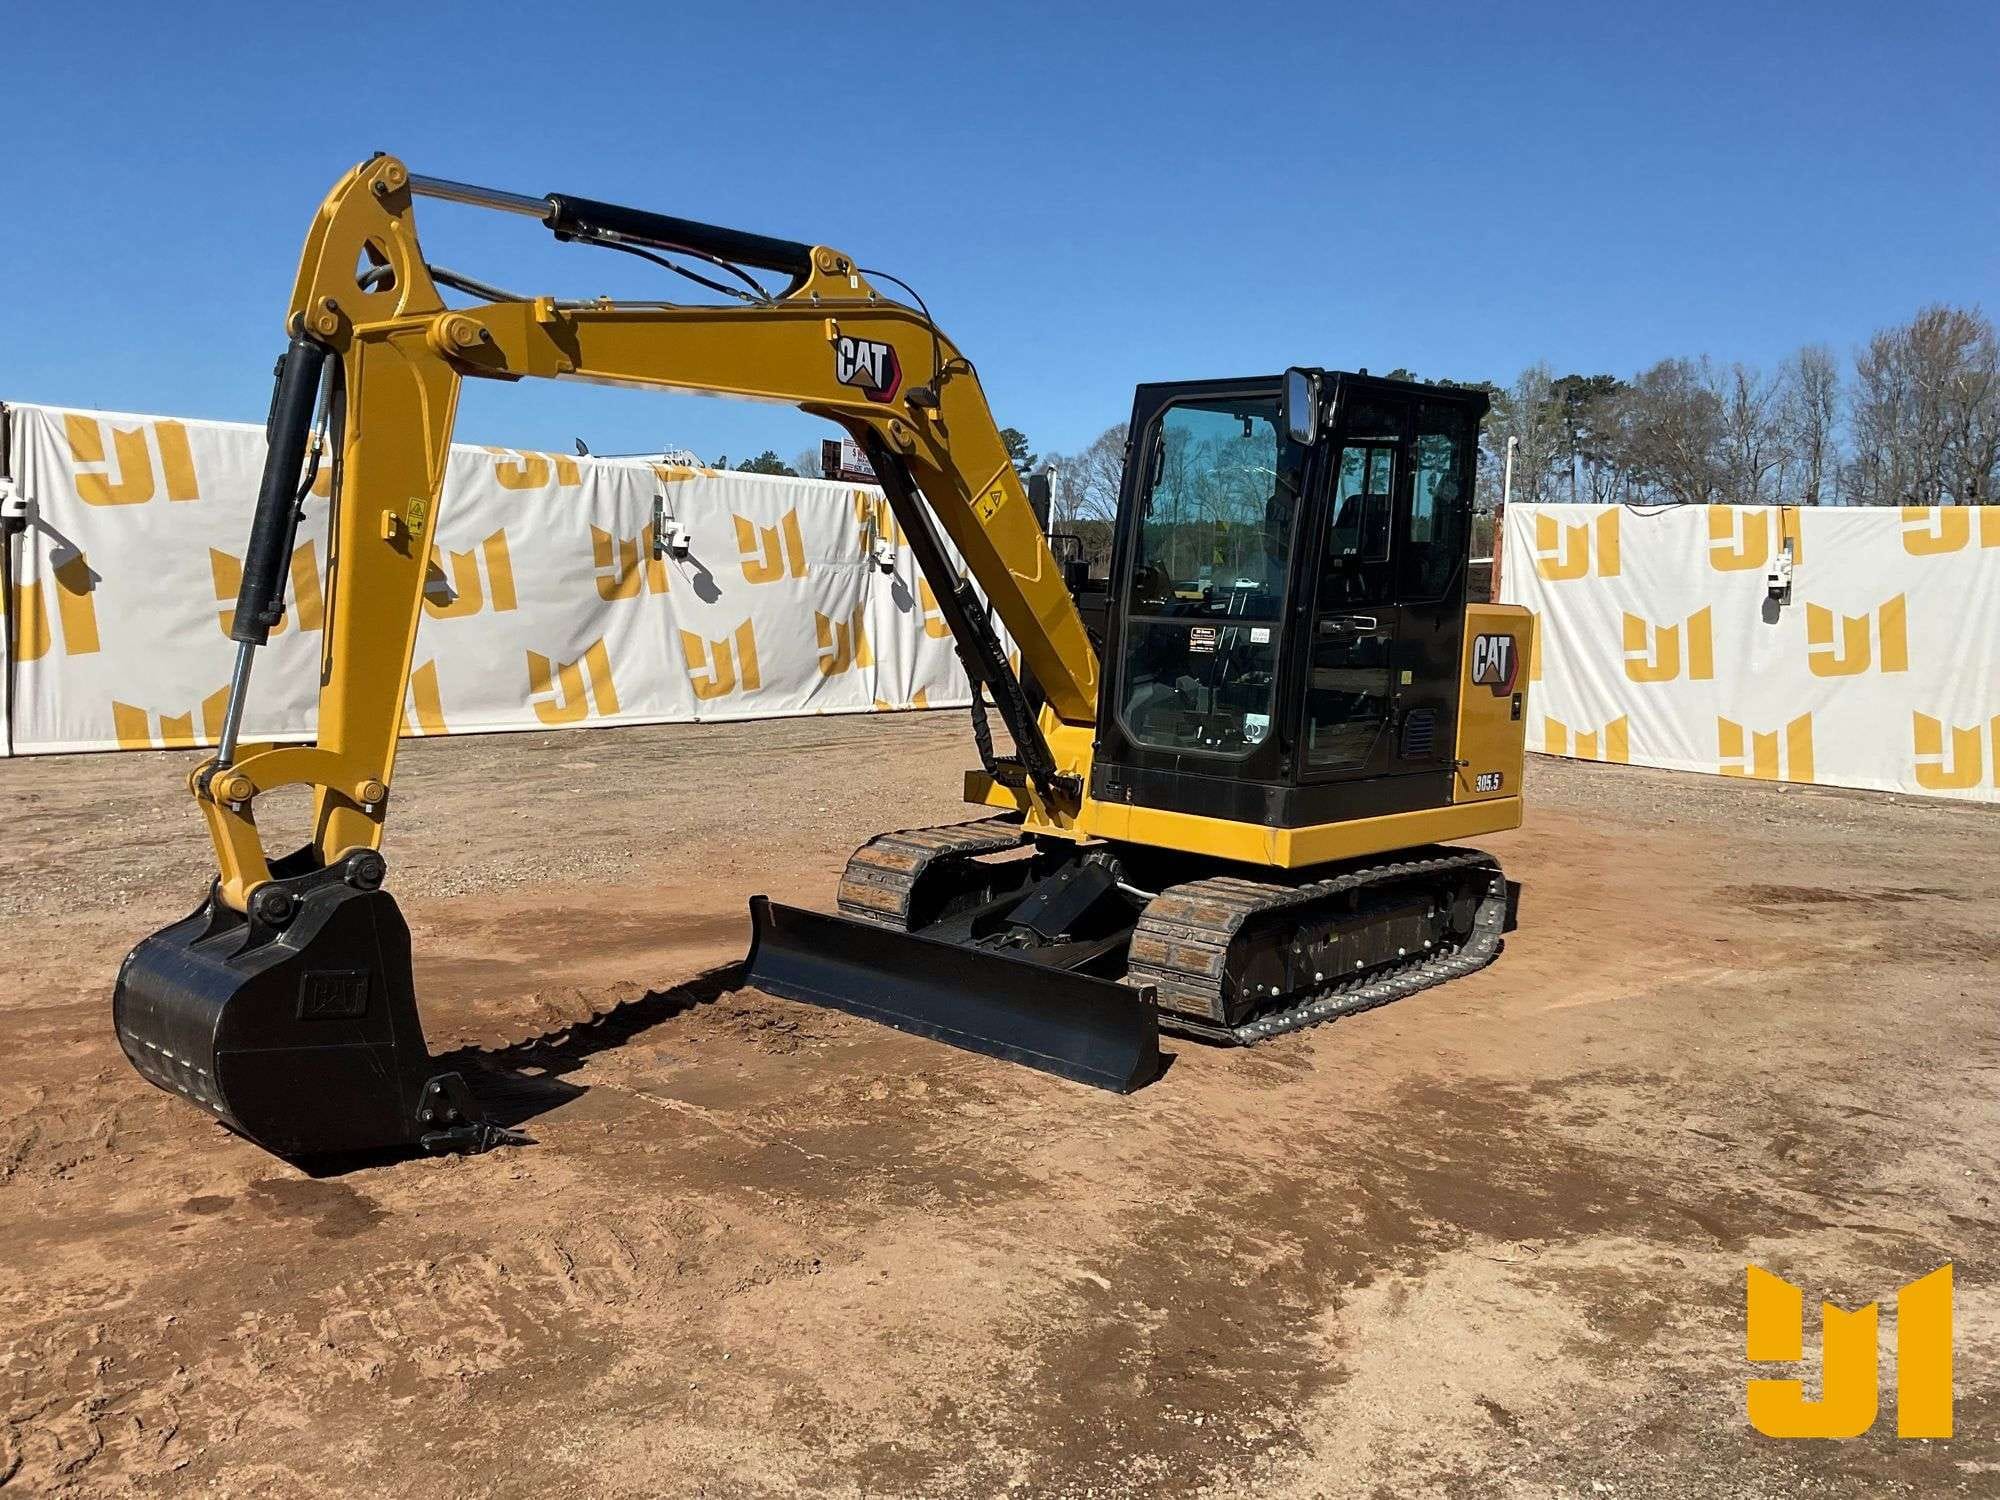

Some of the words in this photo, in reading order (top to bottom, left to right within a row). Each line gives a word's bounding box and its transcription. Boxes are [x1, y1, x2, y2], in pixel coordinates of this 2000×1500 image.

[838, 337, 888, 389] CAT
[1473, 636, 1510, 683] CAT
[1476, 773, 1500, 792] 305.5
